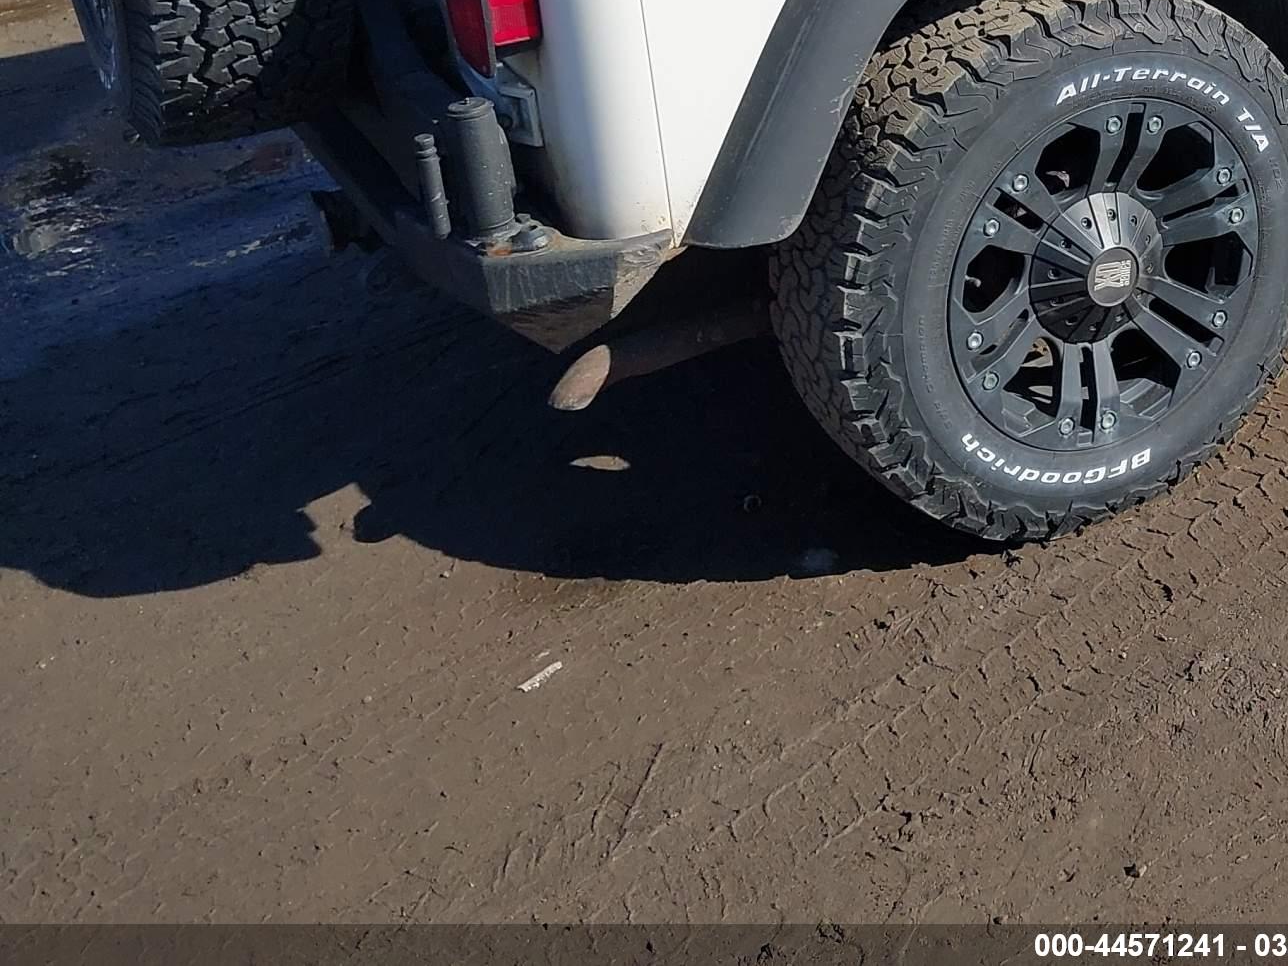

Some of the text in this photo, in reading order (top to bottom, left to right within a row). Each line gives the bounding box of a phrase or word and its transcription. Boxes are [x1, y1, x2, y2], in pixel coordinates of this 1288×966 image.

[1055, 66, 1231, 107] All-Terrain
[1235, 106, 1270, 153] T/A
[960, 433, 1152, 484] BFGoodrich
